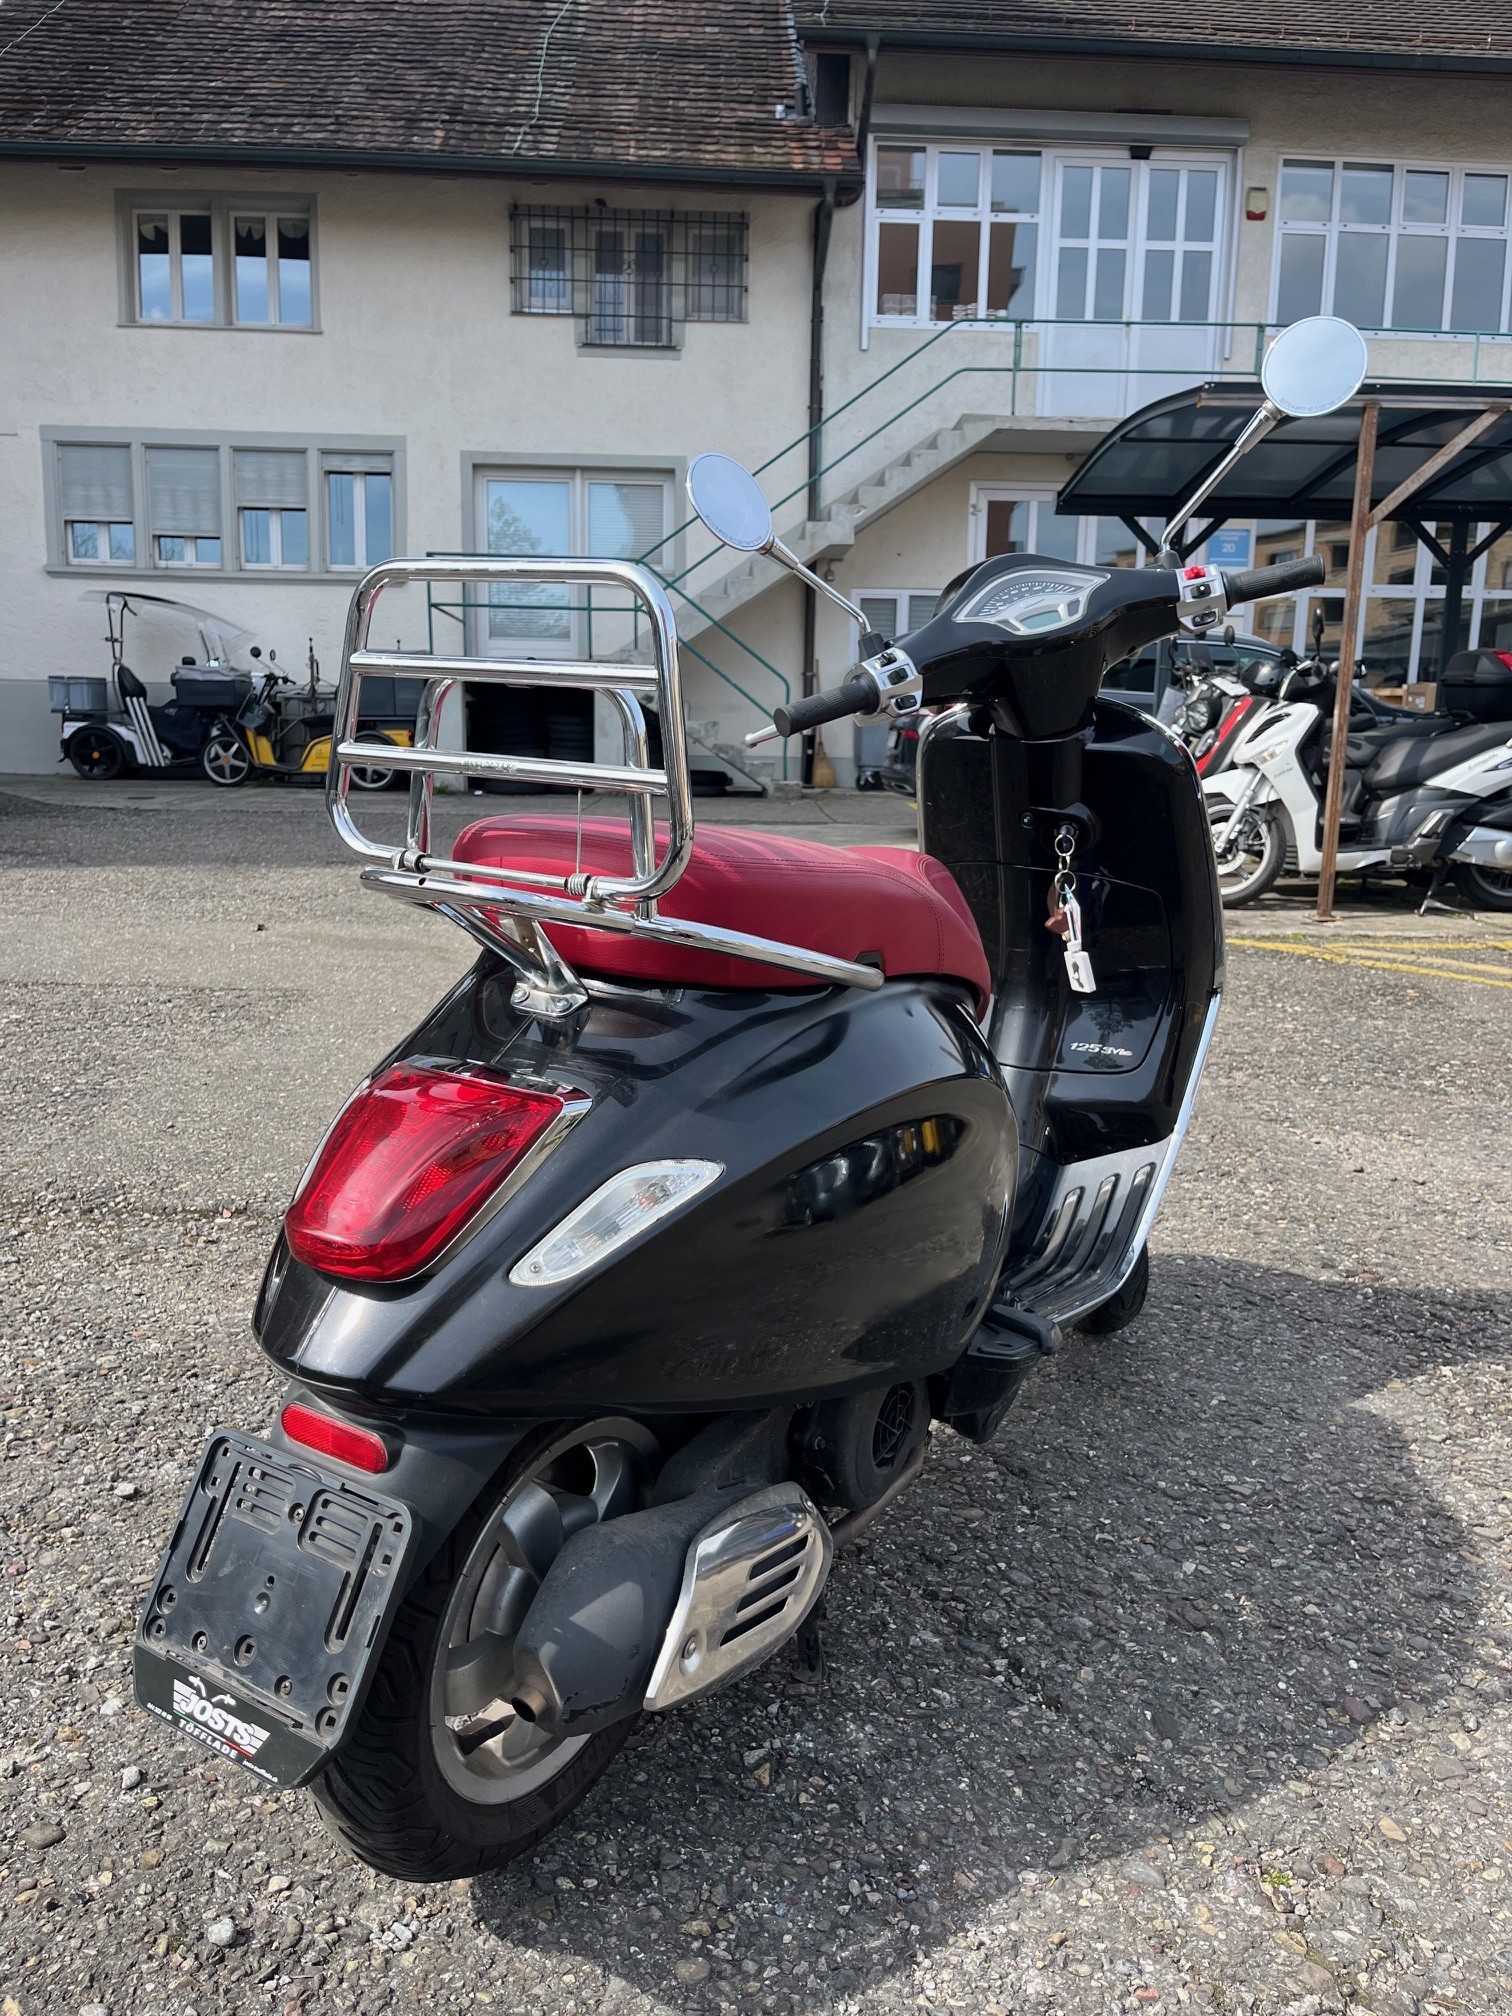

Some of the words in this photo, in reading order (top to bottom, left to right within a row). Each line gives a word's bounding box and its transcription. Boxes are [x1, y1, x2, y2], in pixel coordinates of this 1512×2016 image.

[1070, 1042, 1103, 1053] 125
[179, 1692, 256, 1746] JOSTS
[179, 1718, 239, 1760] TÖFFLADE
